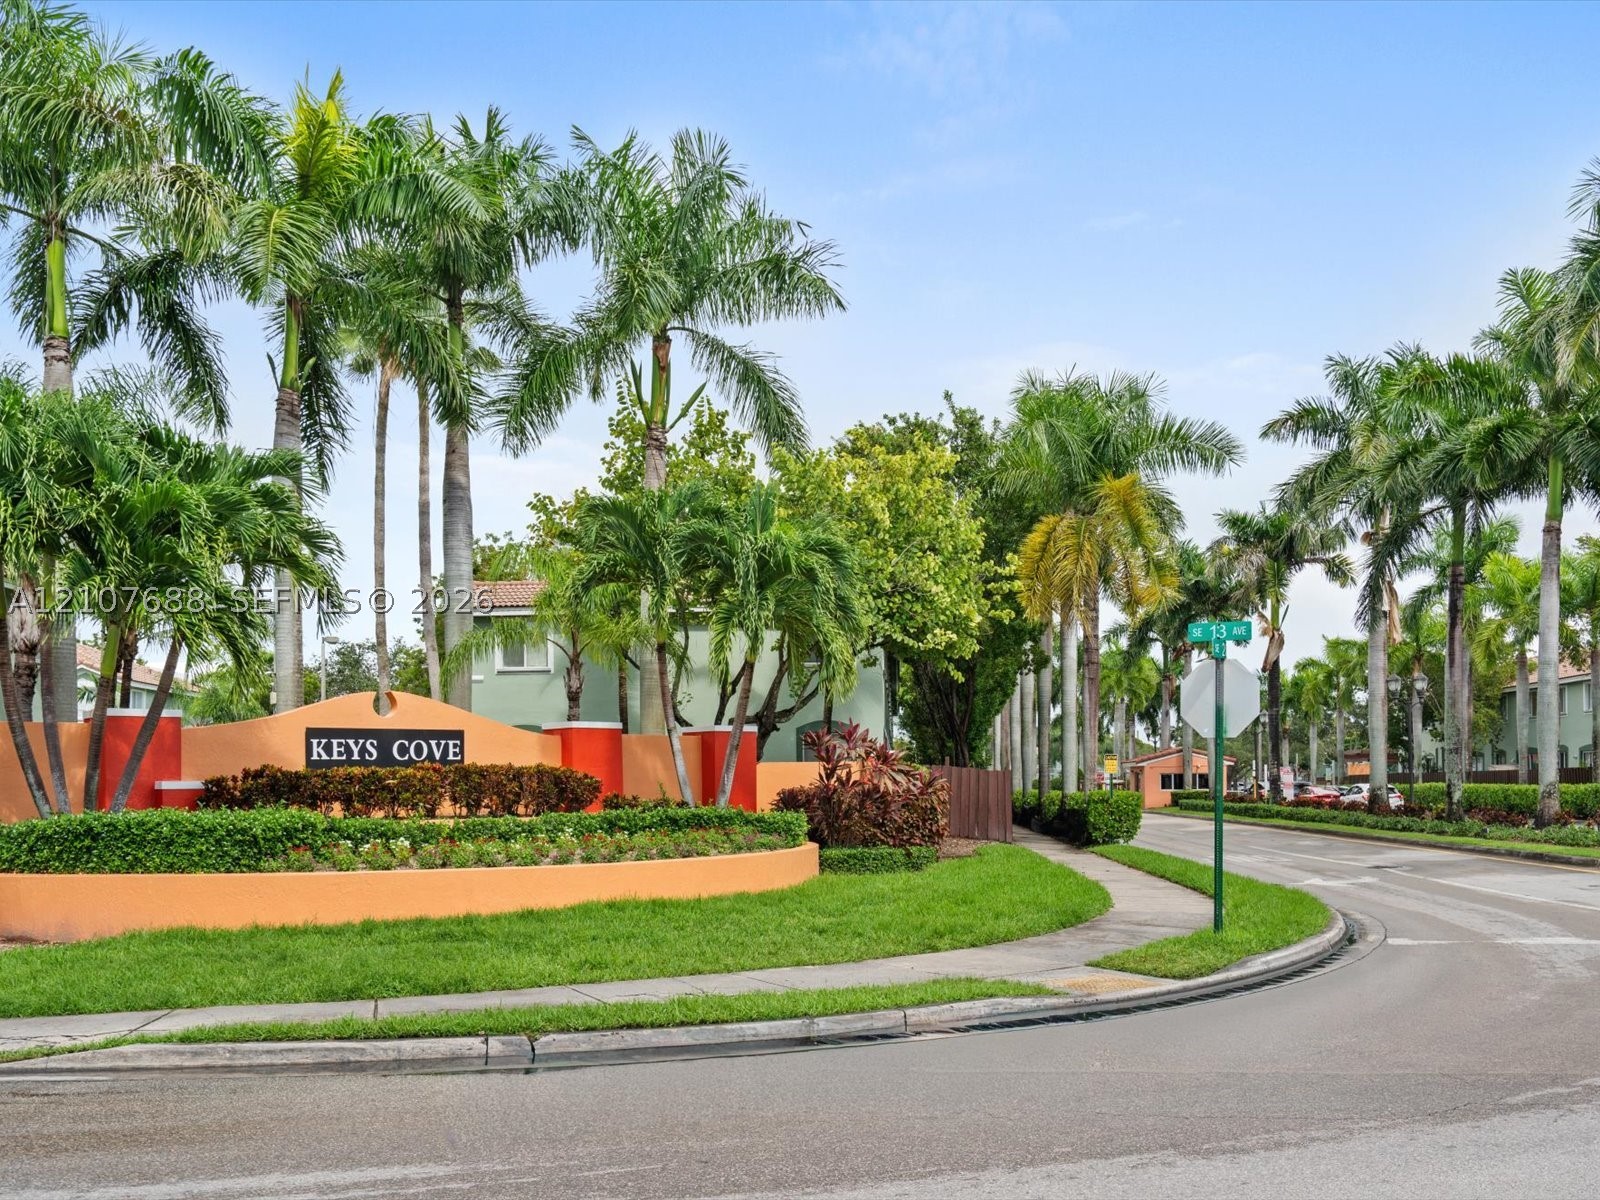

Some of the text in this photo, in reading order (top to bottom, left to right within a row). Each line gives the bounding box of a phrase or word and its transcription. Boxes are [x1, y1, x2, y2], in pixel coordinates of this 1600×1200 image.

[1192, 624, 1247, 639] SE 13 AVE
[310, 739, 462, 761] KEYS COVE
